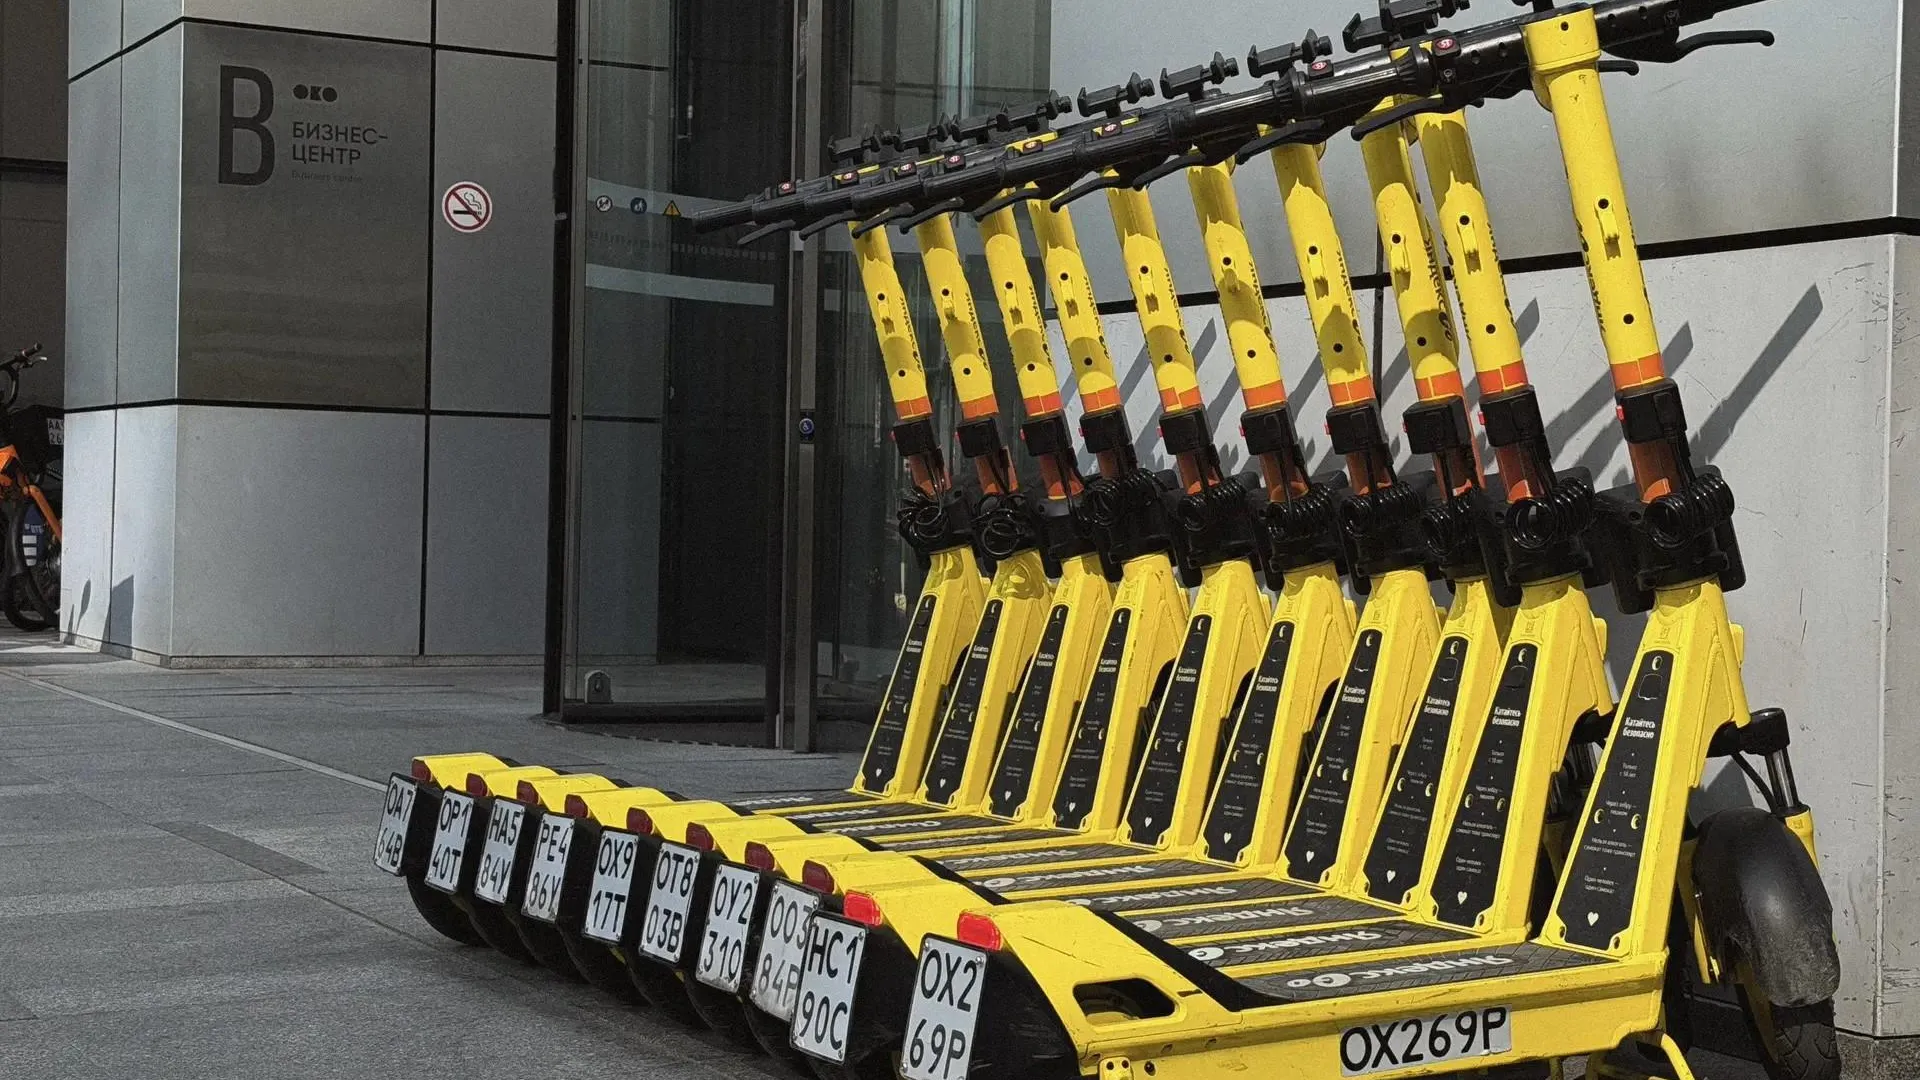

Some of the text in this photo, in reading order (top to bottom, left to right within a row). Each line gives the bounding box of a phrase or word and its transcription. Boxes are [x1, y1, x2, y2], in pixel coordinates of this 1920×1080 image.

[218, 64, 275, 187] В
[292, 121, 388, 145] БИЗНЕС-
[292, 145, 361, 165] ЦЕНТР
[387, 783, 414, 815] ОА7
[439, 797, 467, 837] ОР1
[489, 802, 521, 845] НА5
[538, 823, 567, 864] РЕ4
[376, 827, 403, 867] 64В
[432, 841, 461, 884] 40Т
[599, 837, 633, 879] ОХ9
[480, 849, 510, 894] 84У
[529, 872, 561, 913] 86У
[656, 850, 694, 898] ОТ8
[593, 891, 626, 933] 17Т
[714, 875, 753, 925] ОУ2
[1094, 885, 1238, 904] Яндекс
[646, 905, 683, 954] 03В
[1163, 905, 1314, 927] Яндекс
[808, 922, 858, 985] НС1
[1224, 930, 1383, 953] Яндекс
[758, 952, 802, 1008] 84Р
[920, 948, 977, 1013] ОХ2
[1350, 954, 1514, 980] Яндекс
[799, 990, 847, 1051] 90С
[1339, 1006, 1507, 1072] ОХ269Р
[909, 1018, 966, 1079] 69Р
